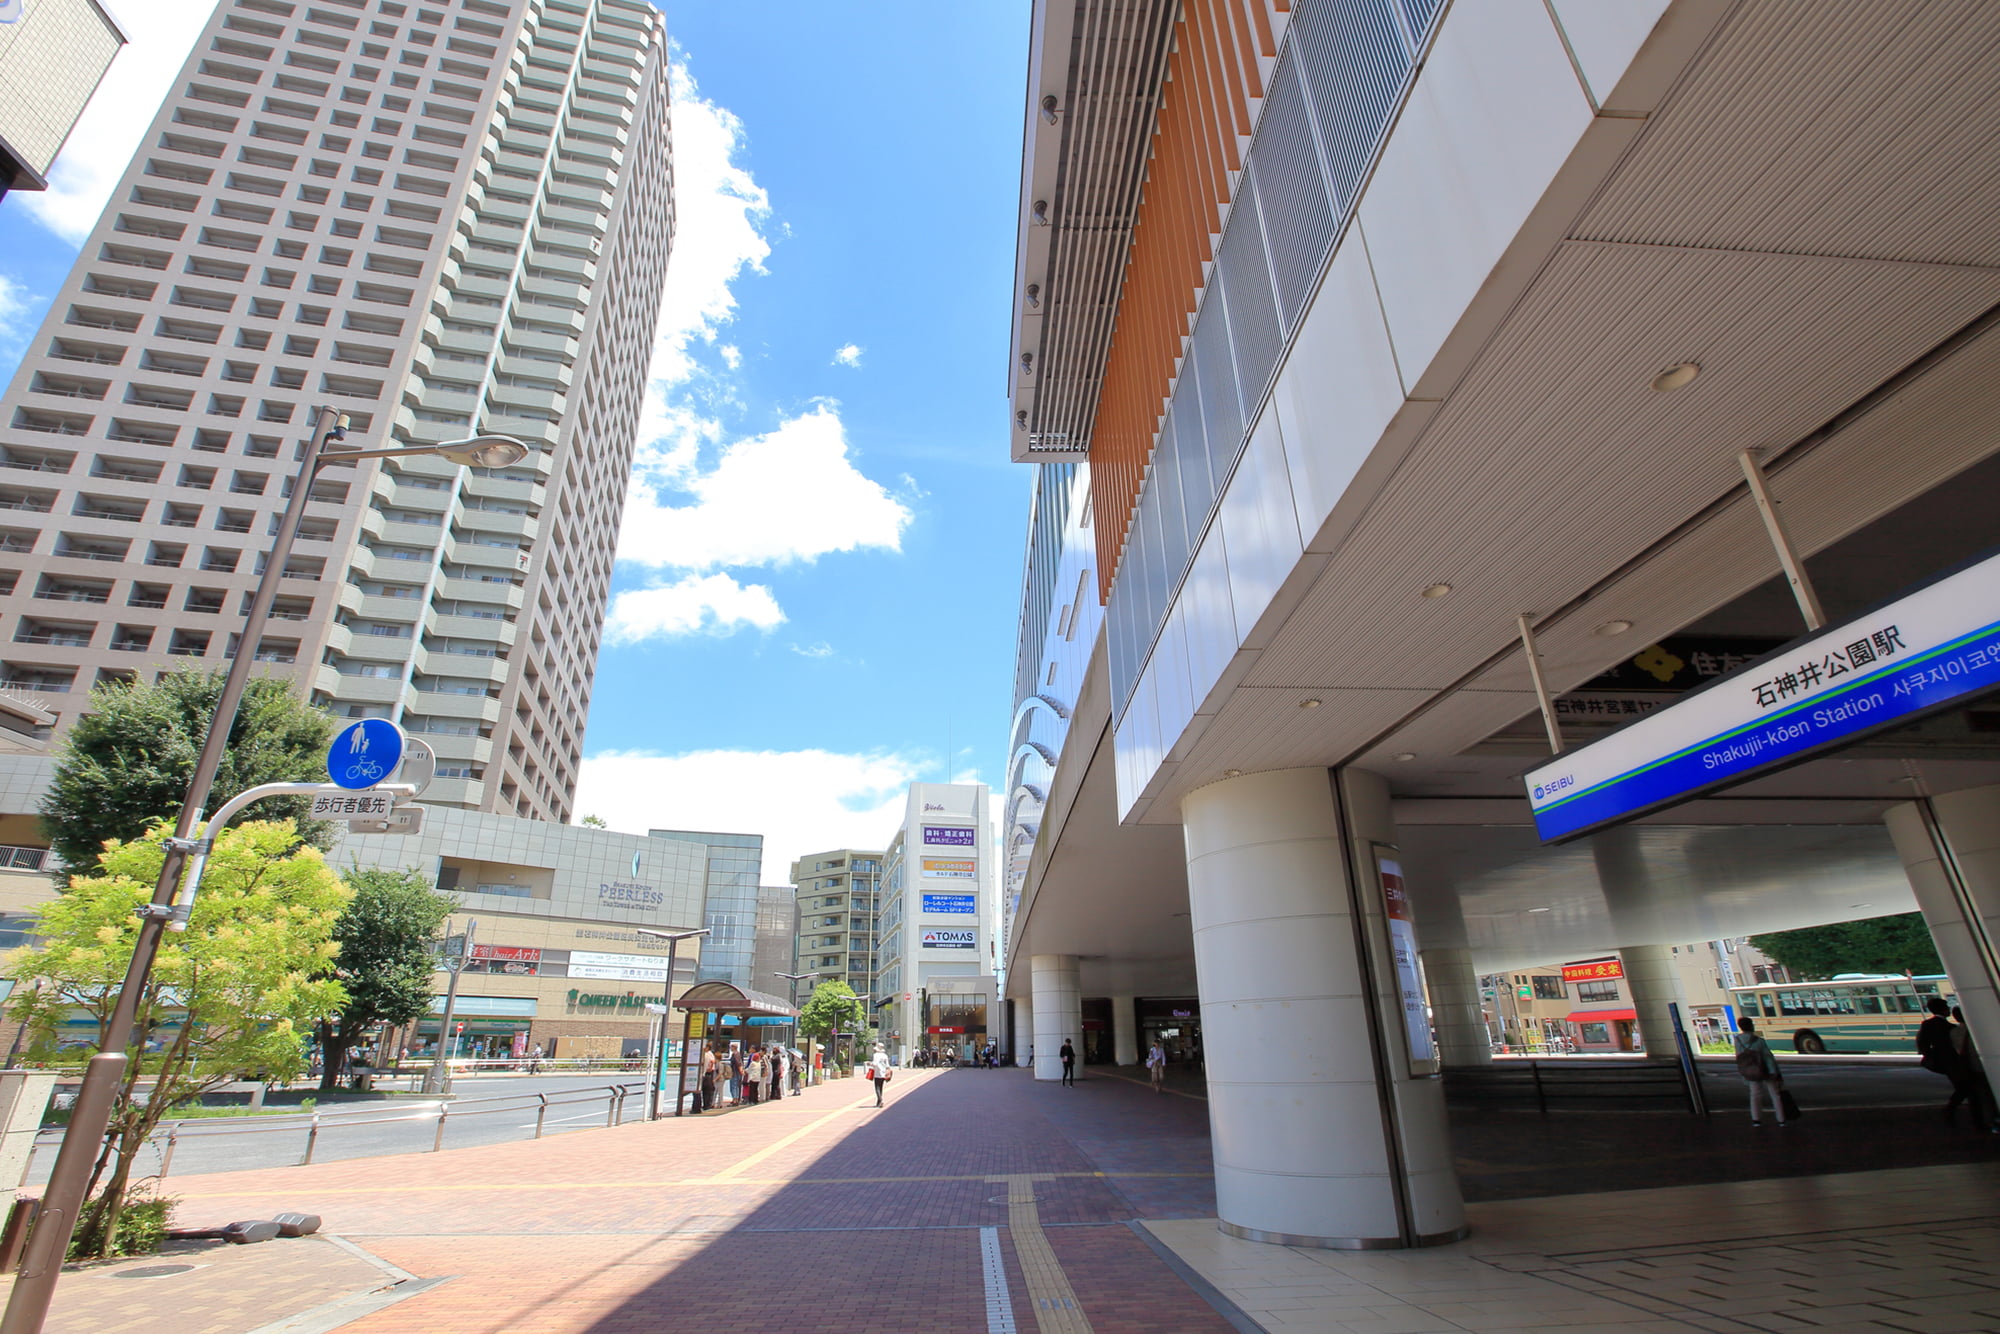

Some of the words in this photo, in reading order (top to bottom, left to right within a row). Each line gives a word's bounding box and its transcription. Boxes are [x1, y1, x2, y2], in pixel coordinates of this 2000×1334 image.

[1751, 624, 1907, 709] 石神井公園駅
[1553, 698, 1661, 715] 石神井営業セ
[1702, 718, 1811, 770] Shakujii-kōen
[1813, 692, 1885, 729] Station
[1544, 774, 1575, 795] SEIBU
[314, 797, 386, 814] 歩行者優先
[599, 884, 663, 904] PEERLESS
[935, 931, 973, 942] TOMAS
[512, 947, 538, 961] Ark
